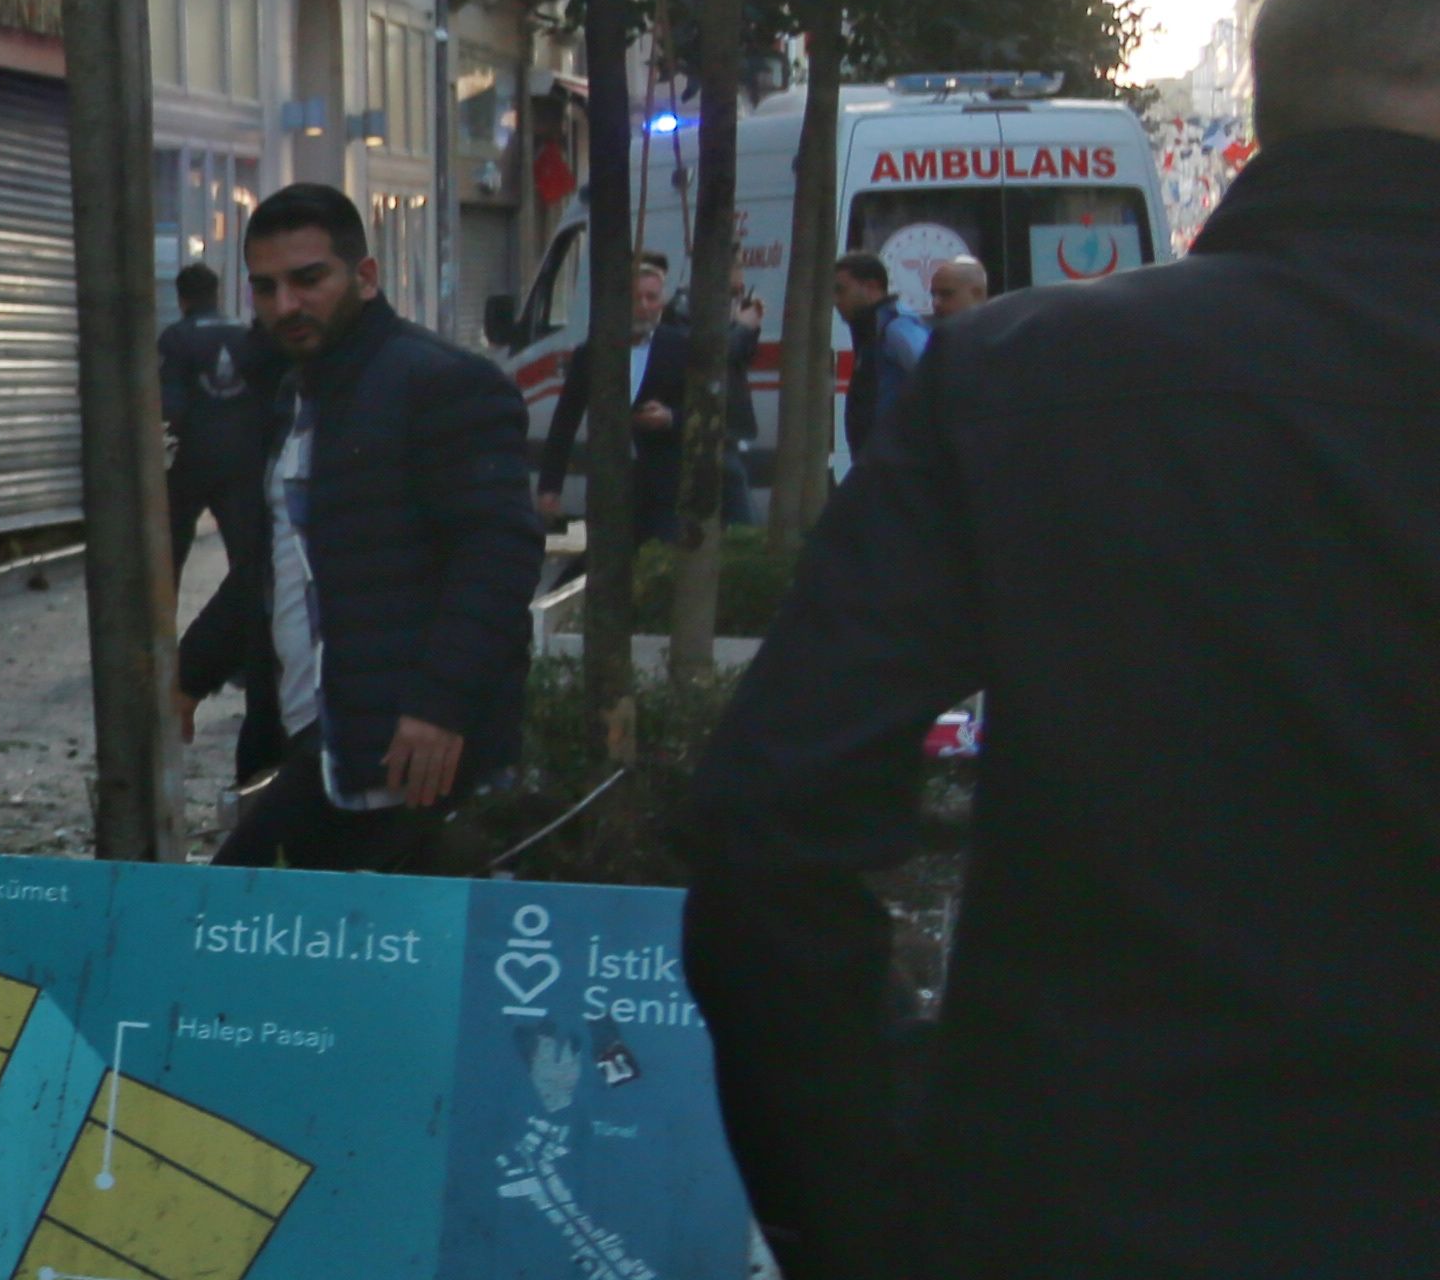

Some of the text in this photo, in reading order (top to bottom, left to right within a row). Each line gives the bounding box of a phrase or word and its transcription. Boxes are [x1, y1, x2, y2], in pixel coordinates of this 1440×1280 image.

[870, 147, 1117, 183] AMBULANS
[194, 913, 421, 964] istiklal.ist
[587, 935, 680, 982] İstik
[176, 1016, 335, 1054] Halep Pasajı
